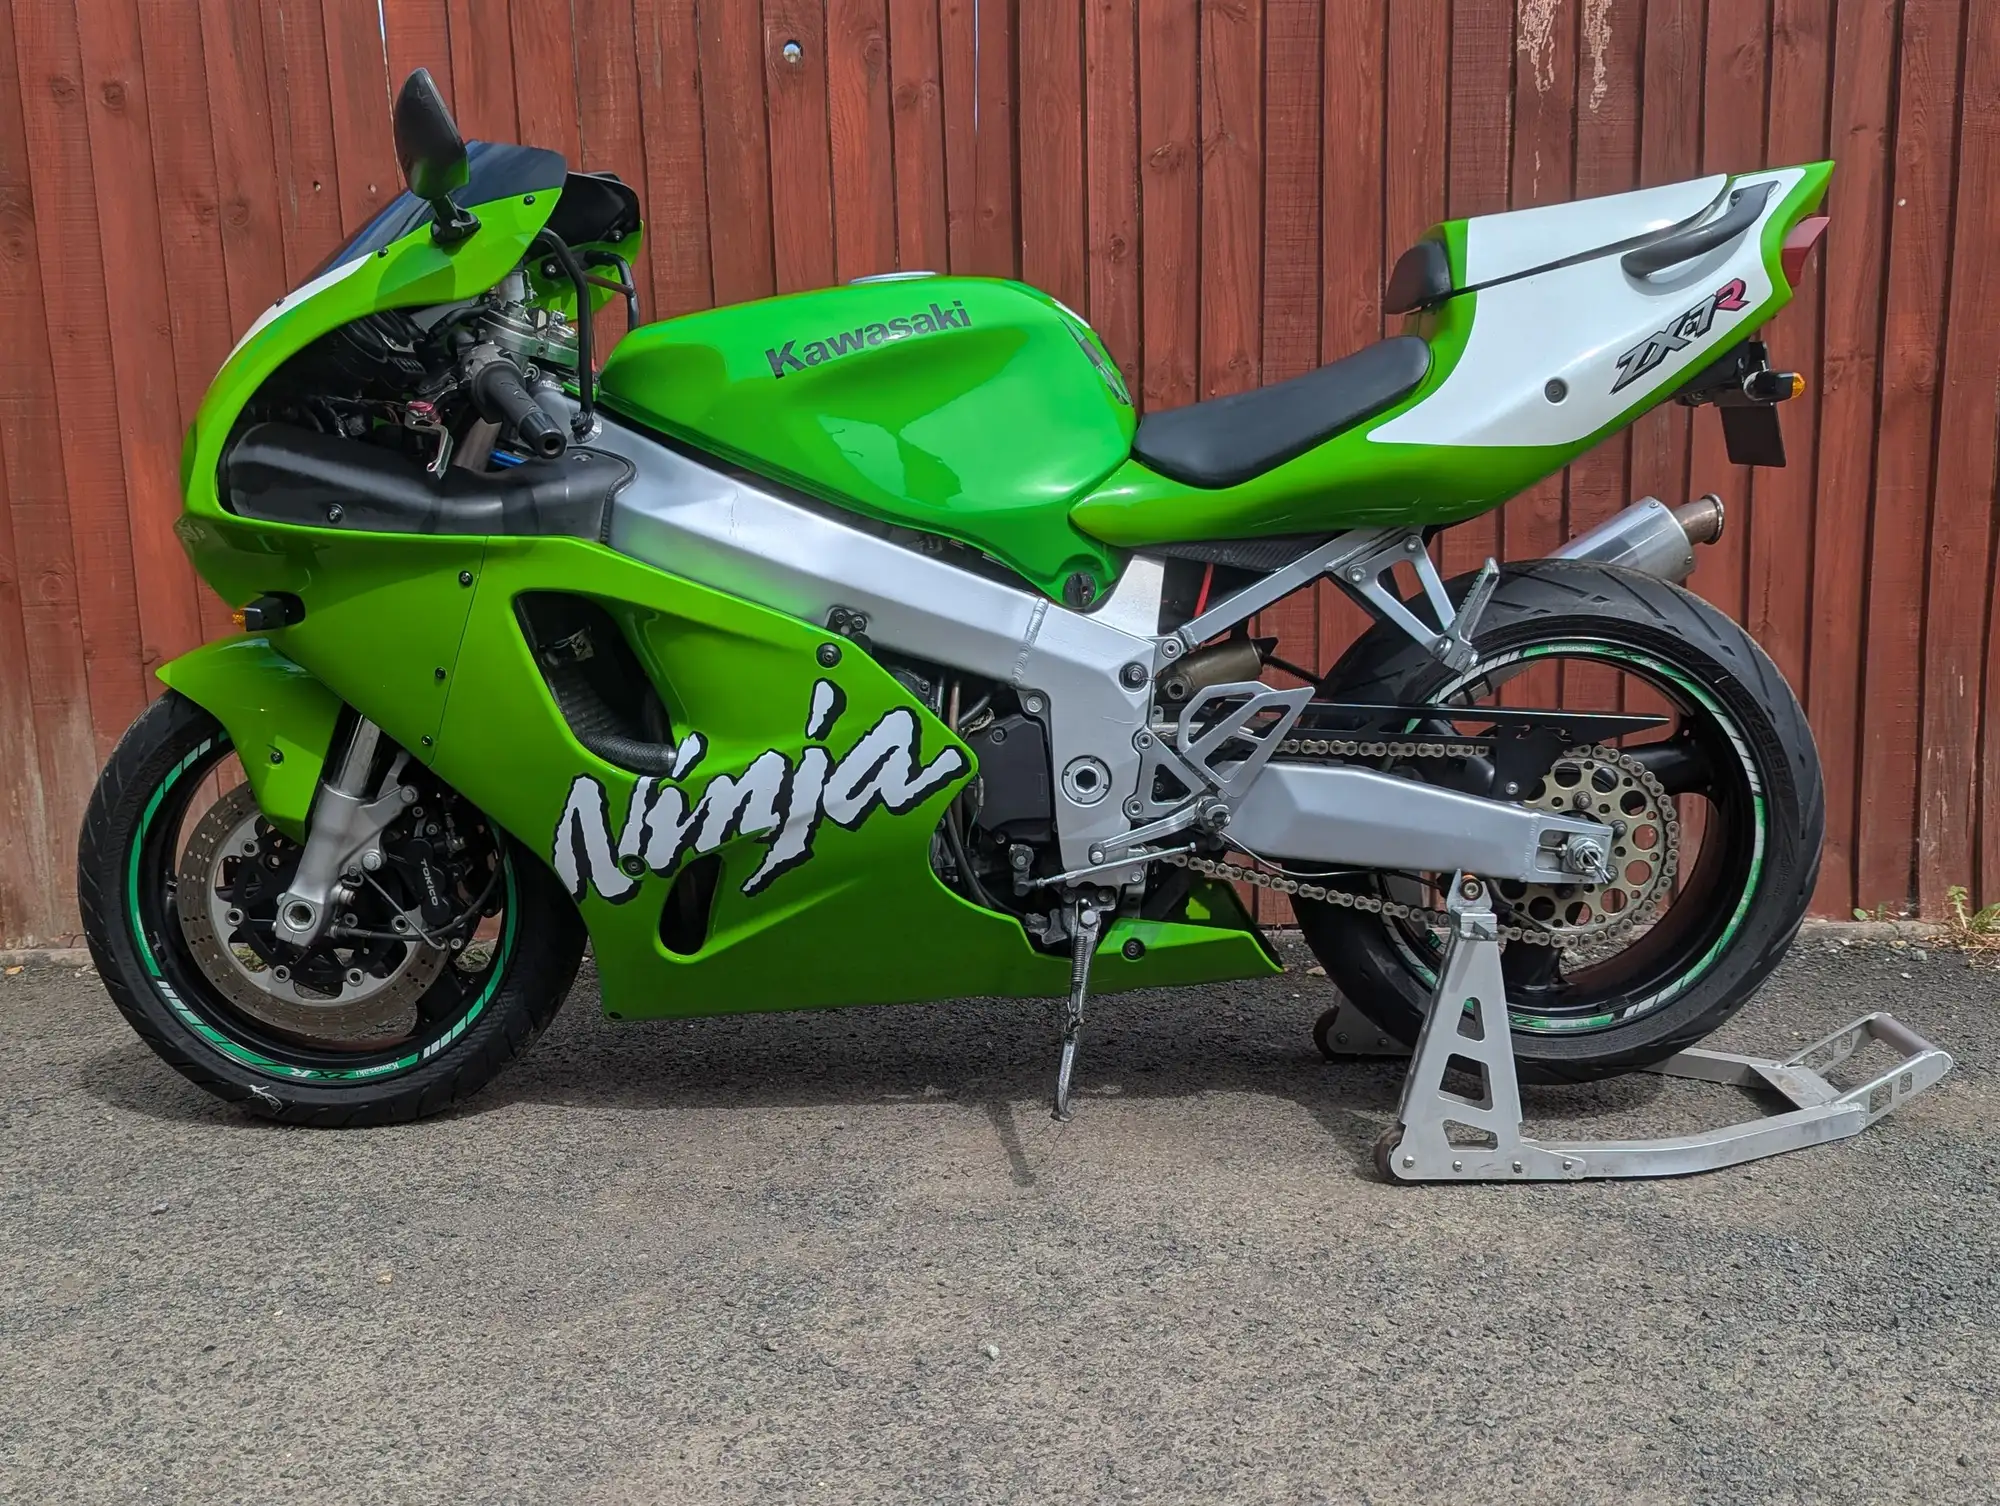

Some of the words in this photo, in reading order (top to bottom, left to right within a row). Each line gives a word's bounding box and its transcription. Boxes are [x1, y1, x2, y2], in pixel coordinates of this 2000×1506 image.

[765, 300, 972, 379] Kawasaki
[552, 677, 970, 906] Ninja
[421, 858, 438, 906] TOKICO
[356, 1061, 399, 1077] Kawasaki
